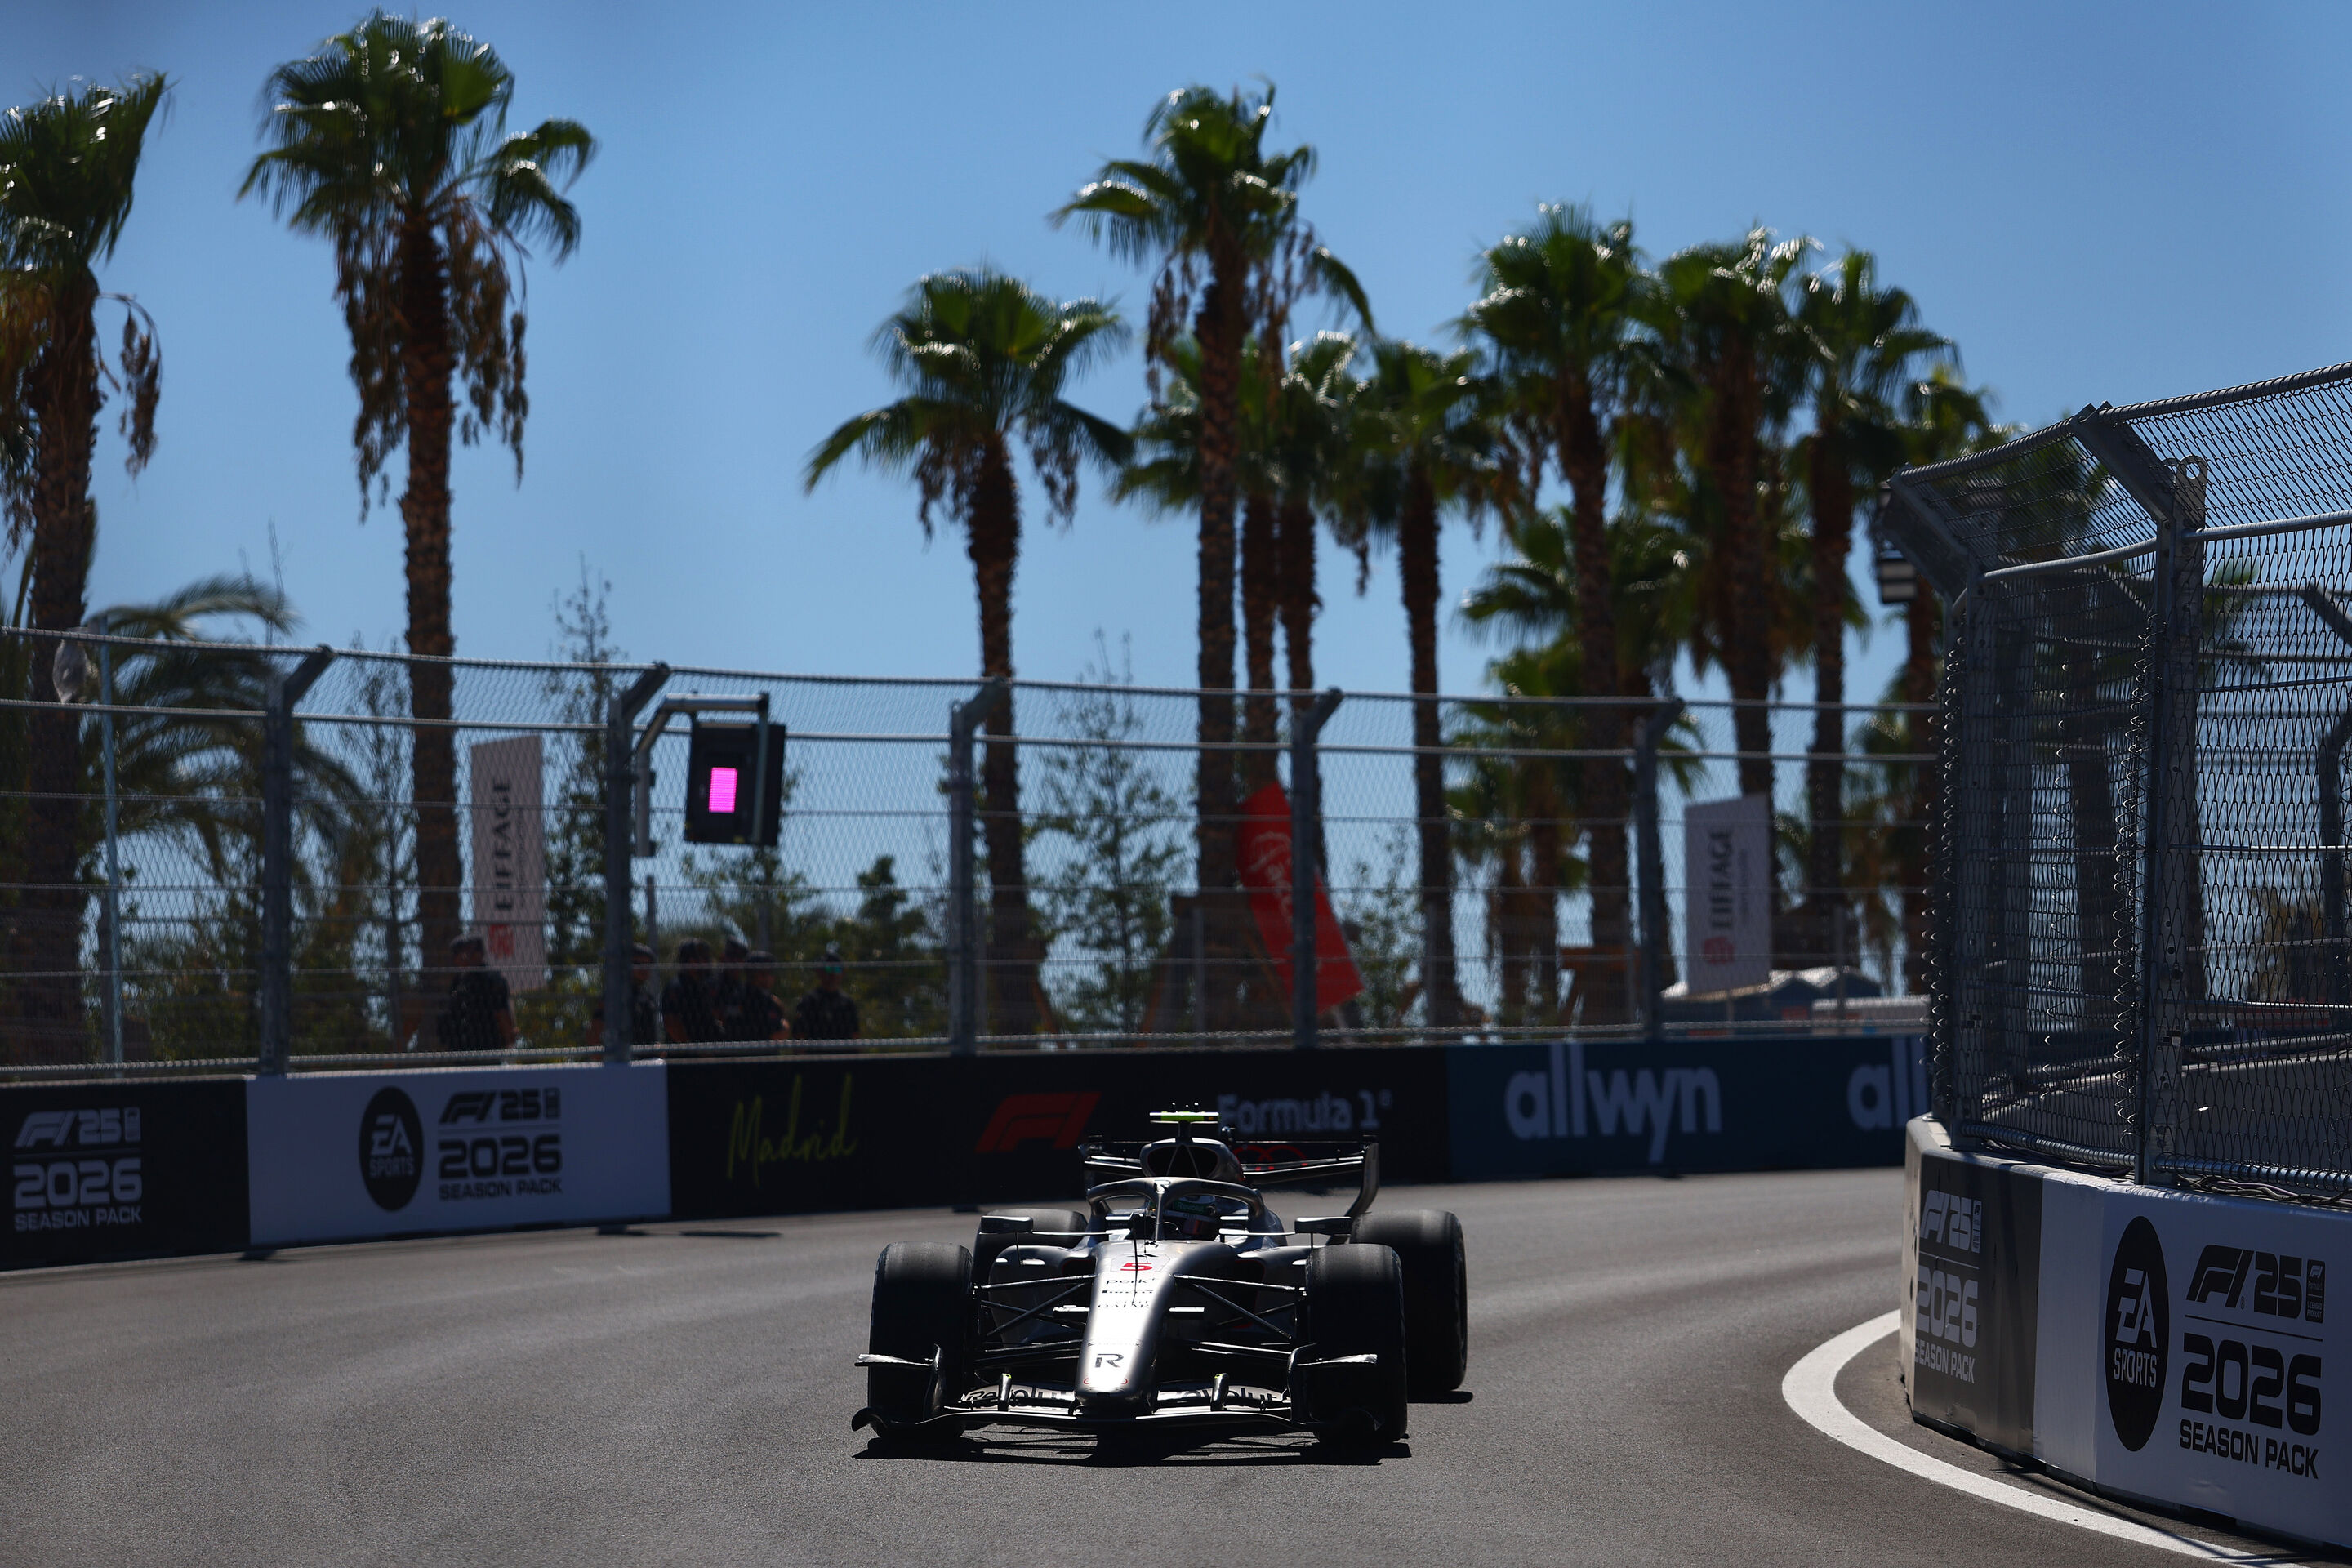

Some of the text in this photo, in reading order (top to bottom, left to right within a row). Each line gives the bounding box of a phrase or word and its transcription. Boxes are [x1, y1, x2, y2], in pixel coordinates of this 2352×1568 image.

[439, 1088, 541, 1124] F1 25
[1505, 1041, 1722, 1163] allwyn
[1847, 1036, 1931, 1132] all
[14, 1107, 122, 1147] F1 25
[371, 1114, 412, 1156] EA
[727, 1071, 858, 1187] Madrid
[976, 1092, 1101, 1152] F1
[1217, 1090, 1354, 1134] Formula
[369, 1156, 415, 1178] SPORTS
[438, 1134, 562, 1180] 2026
[13, 1157, 142, 1209] 2026
[439, 1178, 564, 1200] SEASON PACK
[15, 1205, 142, 1232] SEASON PACK
[1120, 1262, 1153, 1272] 5
[2253, 1251, 2303, 1320] 25
[1916, 1265, 1979, 1348] 2026
[2115, 1267, 2158, 1348] EA
[1094, 1353, 1125, 1368] R
[1915, 1338, 1975, 1384] SEASON PACK
[2114, 1348, 2158, 1388] SPORTS
[2181, 1332, 2322, 1436] 2026
[2180, 1419, 2319, 1480] SEASON PACK
